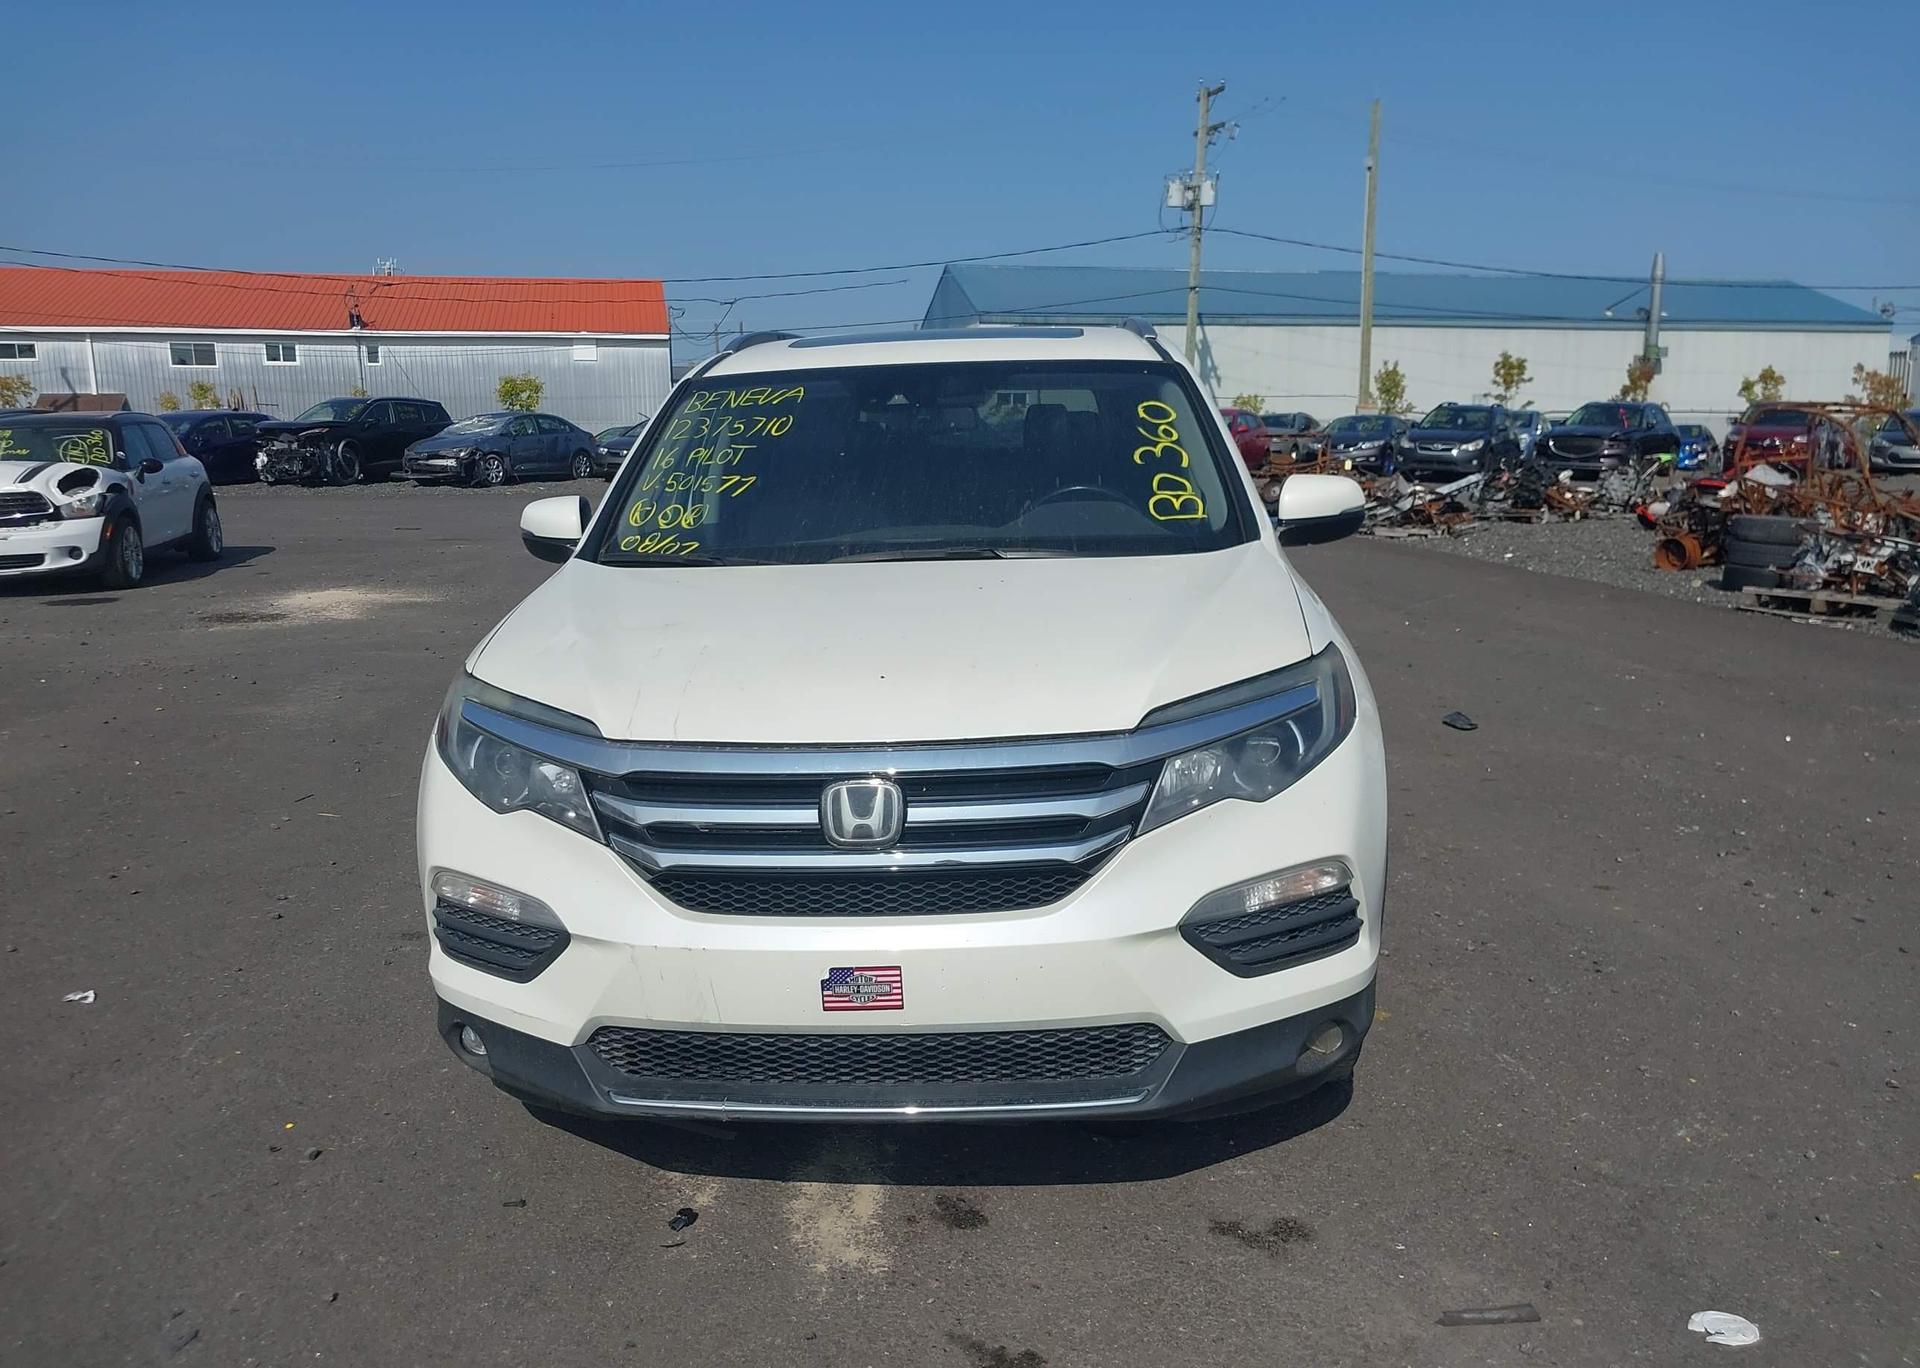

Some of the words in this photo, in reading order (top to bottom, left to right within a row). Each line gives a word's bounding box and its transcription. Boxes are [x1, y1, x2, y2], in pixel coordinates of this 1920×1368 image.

[684, 386, 805, 414] BENEVA
[664, 414, 793, 441] 12375710
[1133, 400, 1190, 468] 360
[652, 447, 675, 470] 16
[685, 444, 758, 467] PILOT
[1148, 472, 1208, 521] BD
[834, 984, 891, 994] HARLEY-DAVIDSON
